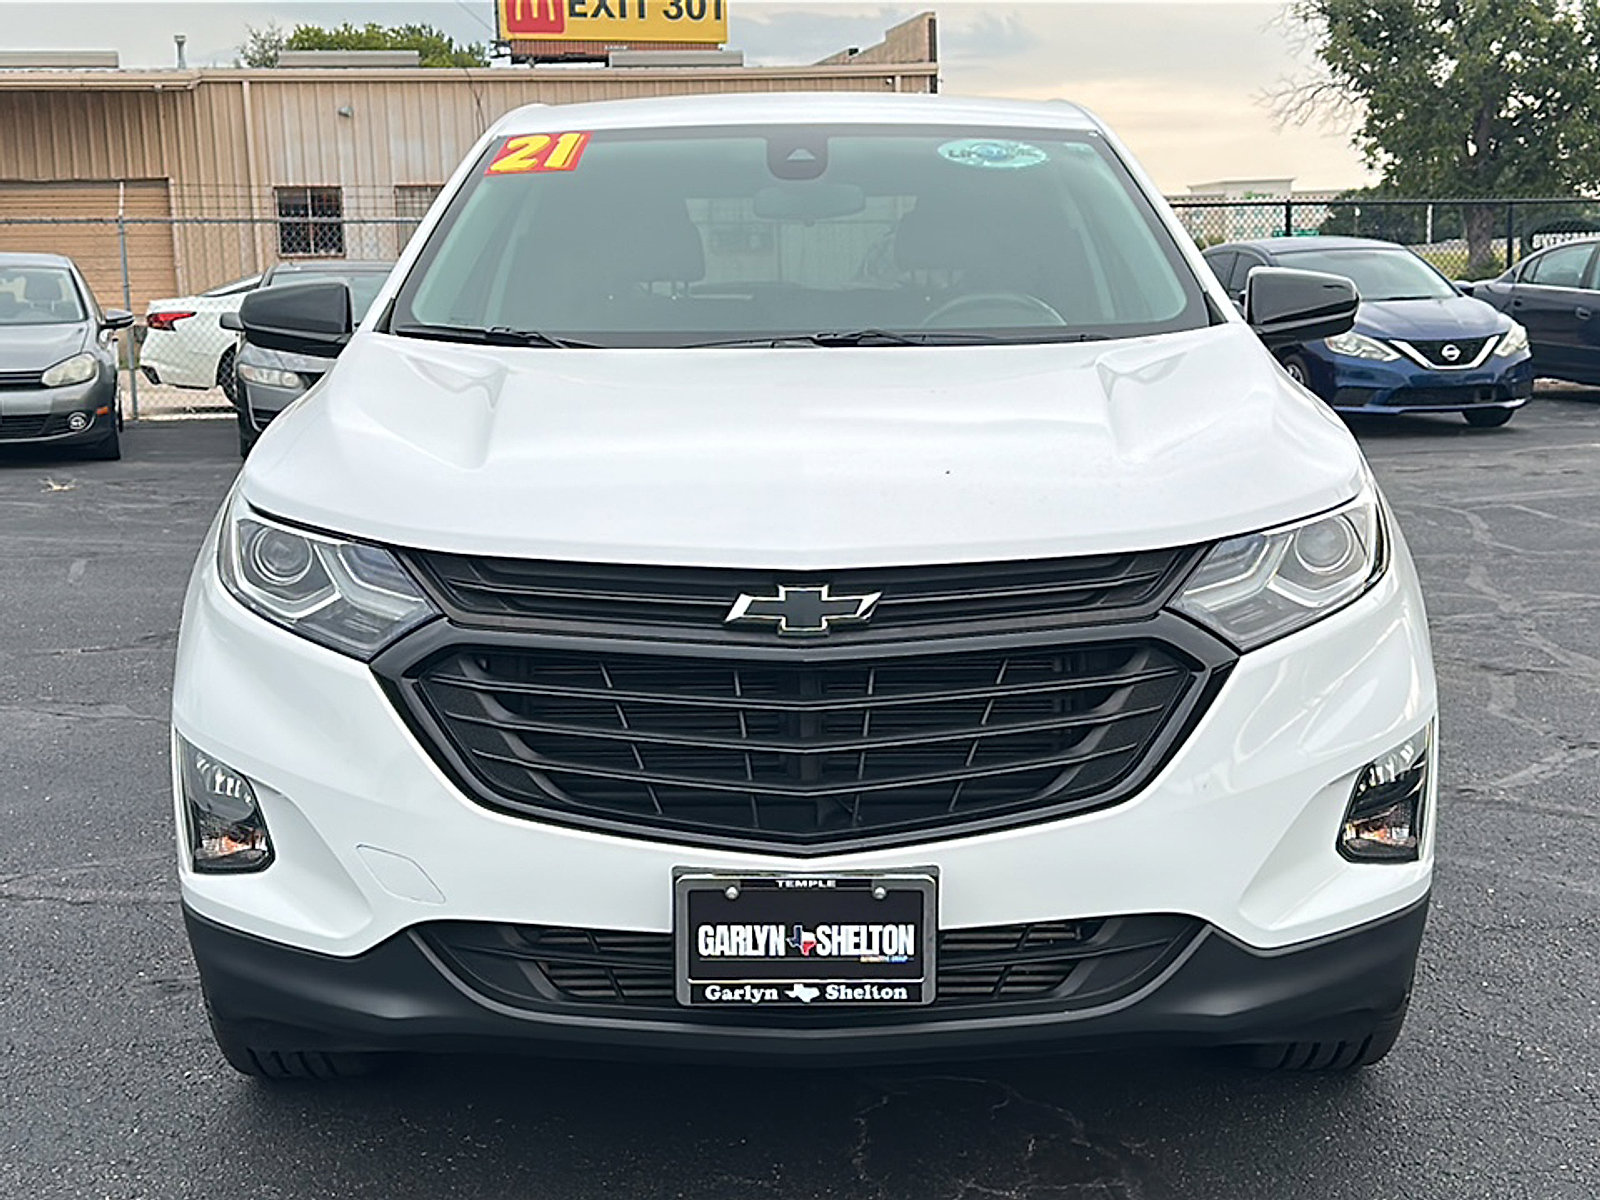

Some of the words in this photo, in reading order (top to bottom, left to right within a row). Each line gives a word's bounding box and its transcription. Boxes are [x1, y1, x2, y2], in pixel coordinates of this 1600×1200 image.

[490, 133, 585, 171] 21
[776, 880, 836, 888] TEMPLE
[698, 925, 786, 956] GARLYN
[817, 925, 915, 956] SHELTON
[705, 986, 779, 1003] Garlyn
[825, 984, 908, 1000] Shelton
